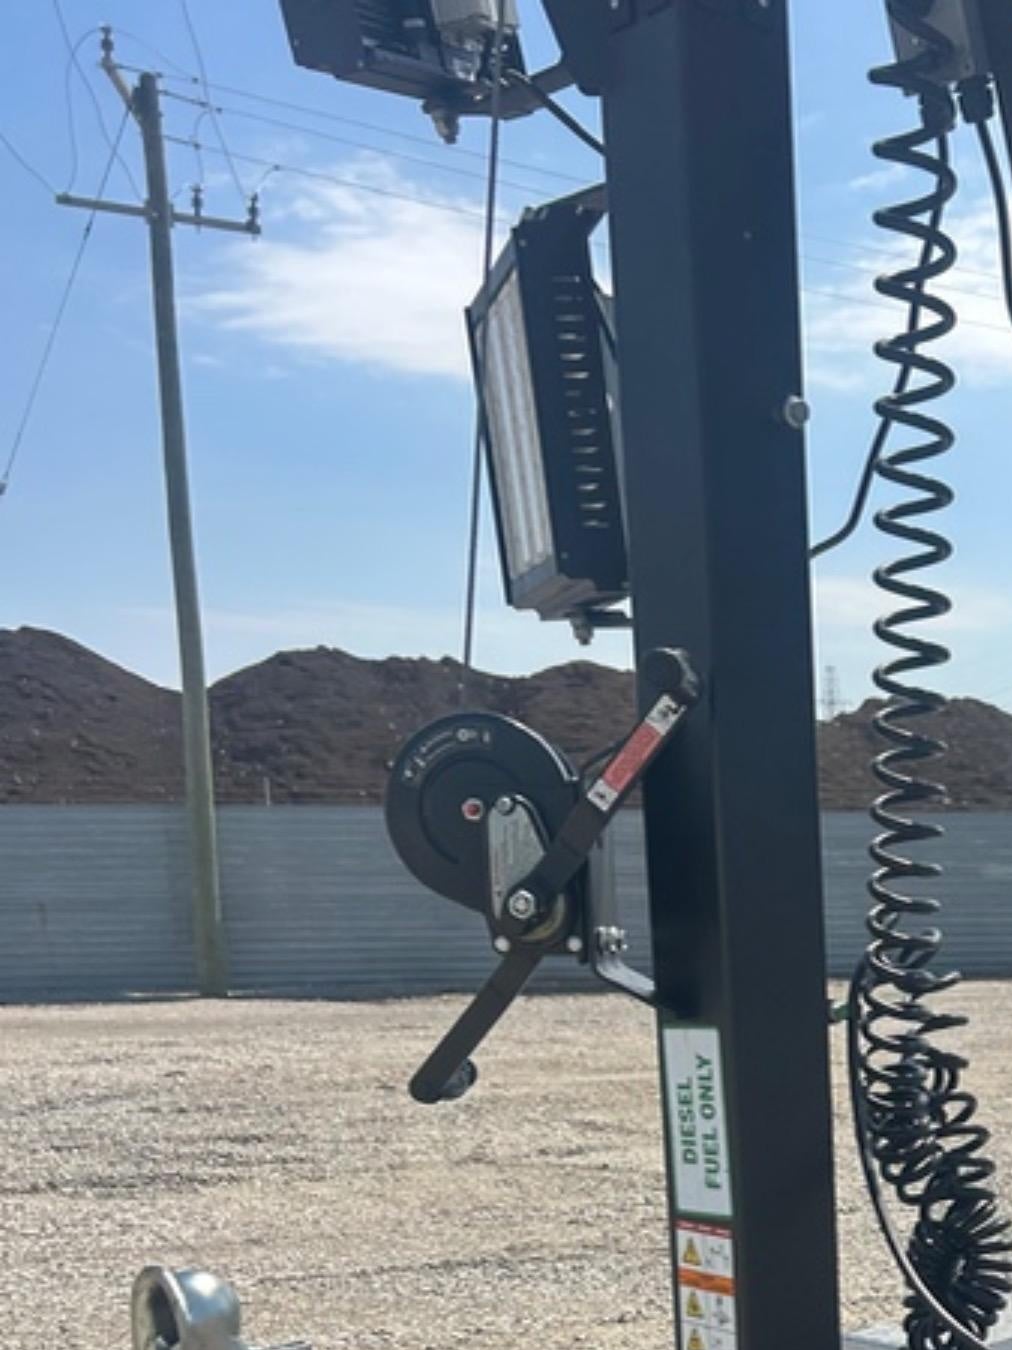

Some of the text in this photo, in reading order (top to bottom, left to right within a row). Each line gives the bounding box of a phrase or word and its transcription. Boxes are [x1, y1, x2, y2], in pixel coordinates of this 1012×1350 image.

[677, 1076, 698, 1165] DIESEL
[695, 1054, 722, 1189] FUEL ONLY
